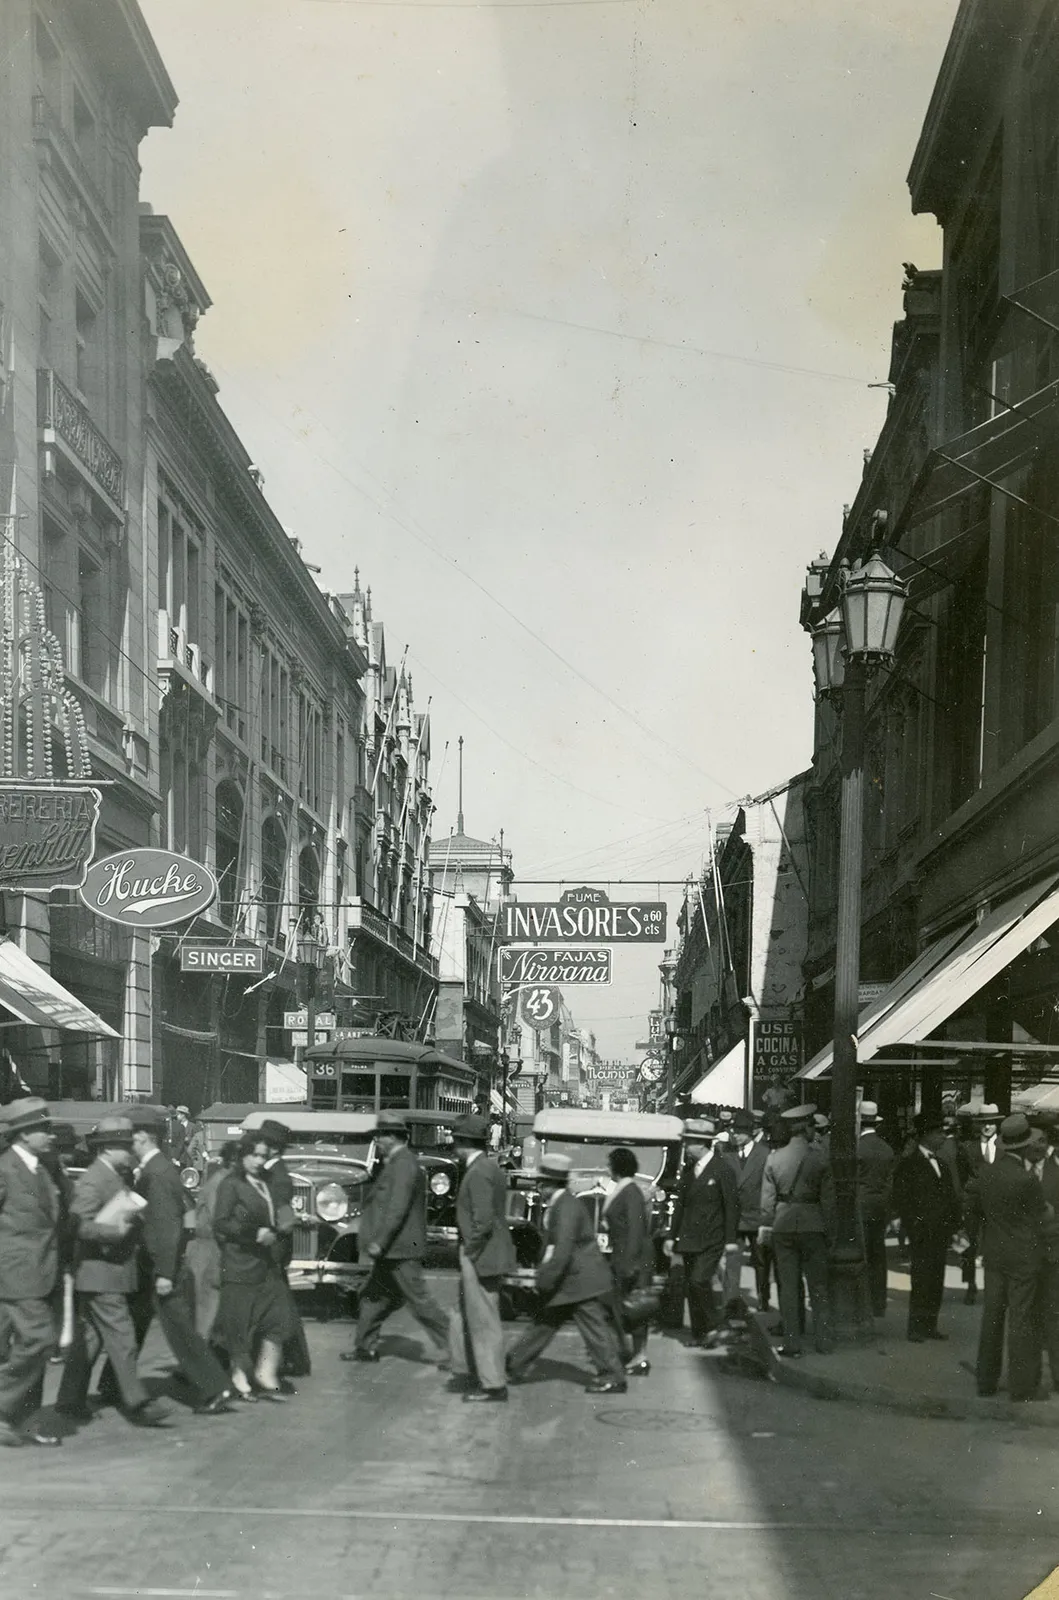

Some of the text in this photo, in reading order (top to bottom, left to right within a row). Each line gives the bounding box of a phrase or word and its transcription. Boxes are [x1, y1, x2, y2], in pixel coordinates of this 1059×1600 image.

[97, 859, 203, 906] Hucke
[567, 893, 602, 903] FUME
[506, 906, 642, 937] INVASORES
[650, 910, 662, 922] 60
[644, 922, 660, 935] cts
[187, 951, 257, 967] SINGER
[553, 952, 608, 962] FAJAS
[502, 951, 609, 981] Nirvana
[526, 988, 555, 1021] 43
[288, 1015, 331, 1025] ROAL
[761, 1023, 795, 1035] USE
[756, 1037, 799, 1053] COCINA
[756, 1055, 798, 1066] A GAS
[315, 1062, 335, 1076] 36
